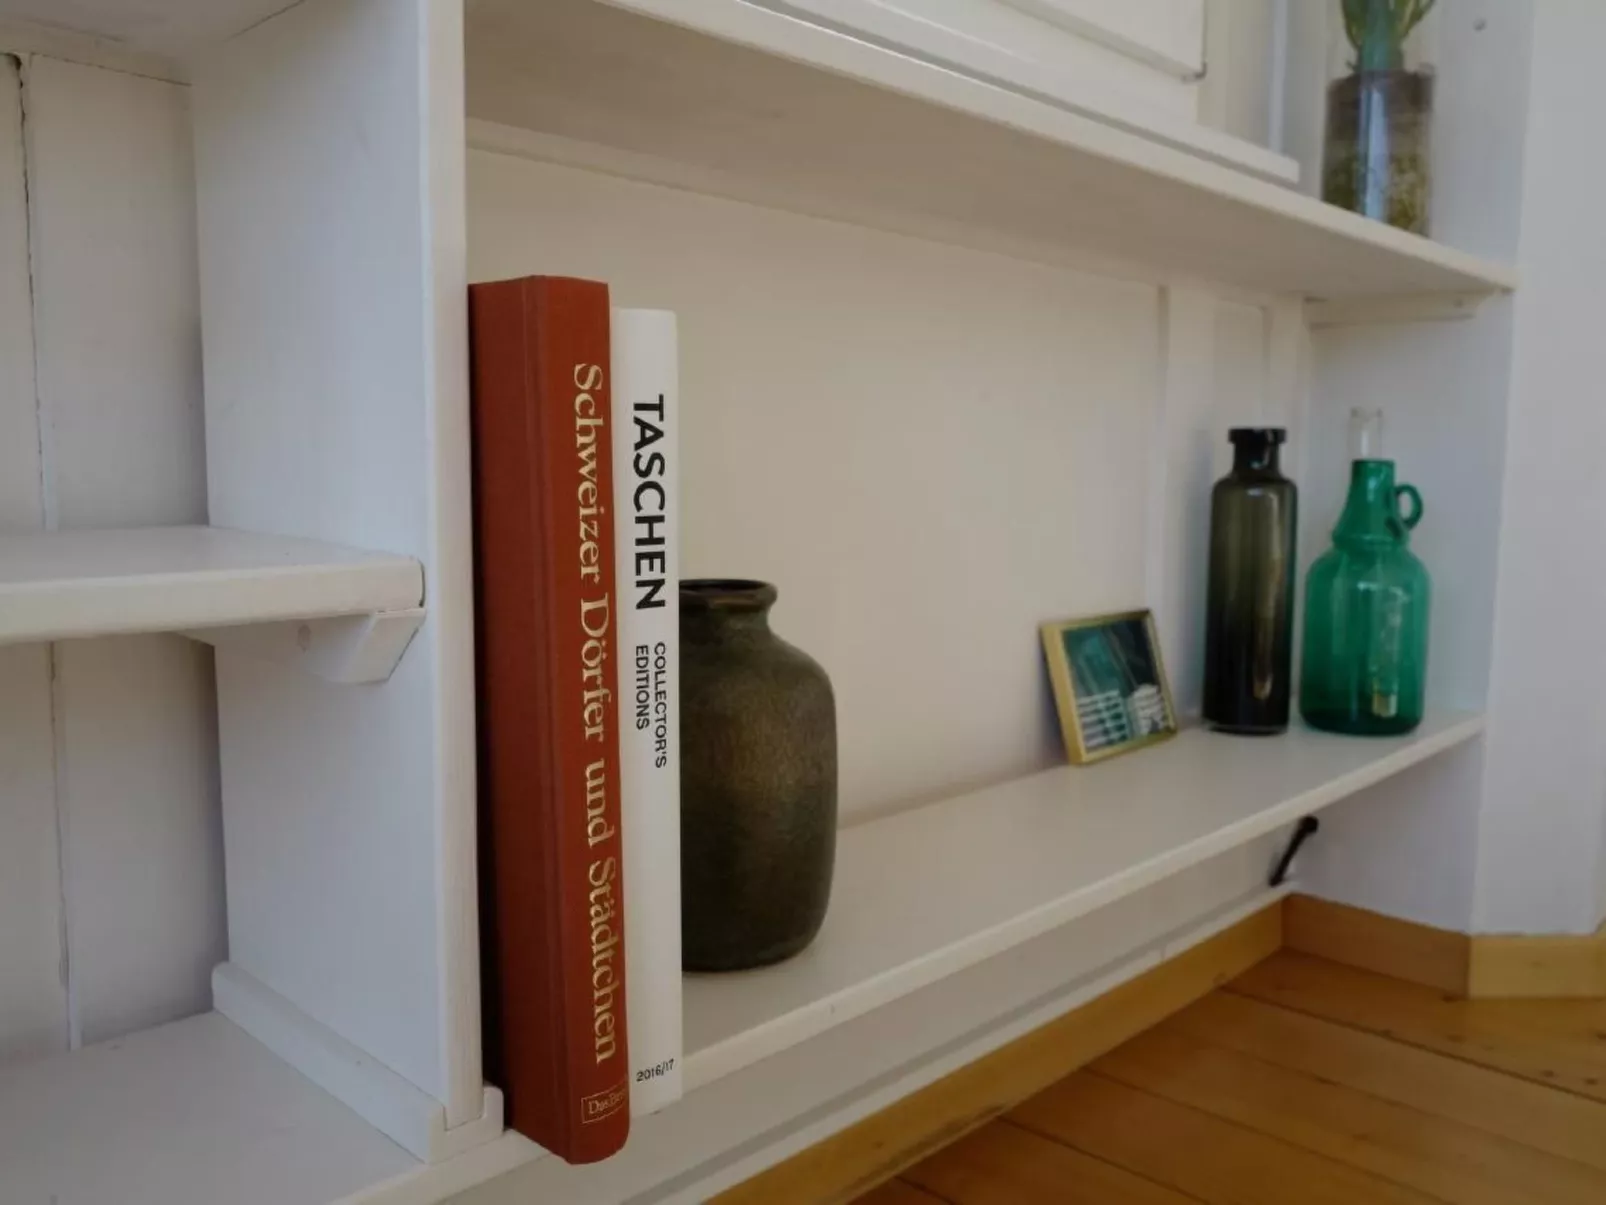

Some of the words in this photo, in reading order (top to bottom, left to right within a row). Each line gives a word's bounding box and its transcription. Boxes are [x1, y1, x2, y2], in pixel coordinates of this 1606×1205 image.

[573, 363, 604, 584] Schweizer
[633, 393, 667, 610] TASCHEN
[580, 592, 612, 743] Dörfer
[635, 644, 650, 731] EDITIONS
[654, 641, 667, 769] COLLECTOR'S
[585, 757, 615, 849] und
[588, 856, 620, 1065] Städtchen
[636, 1058, 675, 1082] 2016/17
